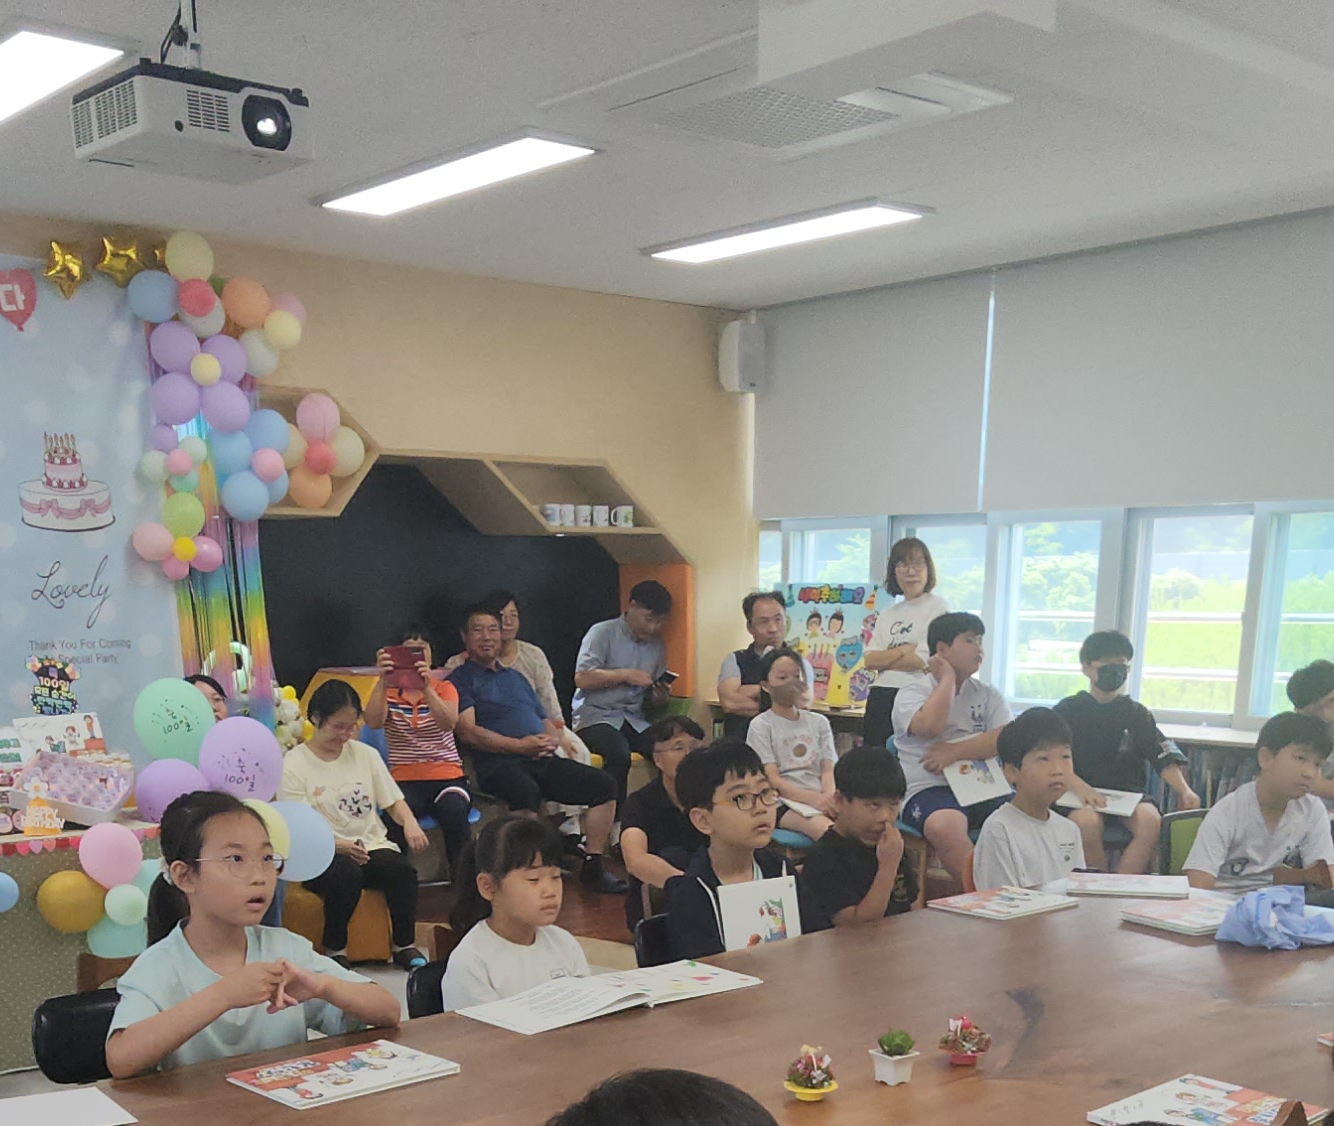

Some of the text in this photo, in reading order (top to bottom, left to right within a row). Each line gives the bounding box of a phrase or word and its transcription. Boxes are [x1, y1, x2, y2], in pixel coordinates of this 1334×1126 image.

[0, 283, 26, 311] 다
[31, 554, 112, 629] Lovely
[29, 638, 132, 651] Thank You For Coming
[96, 653, 118, 664] Party
